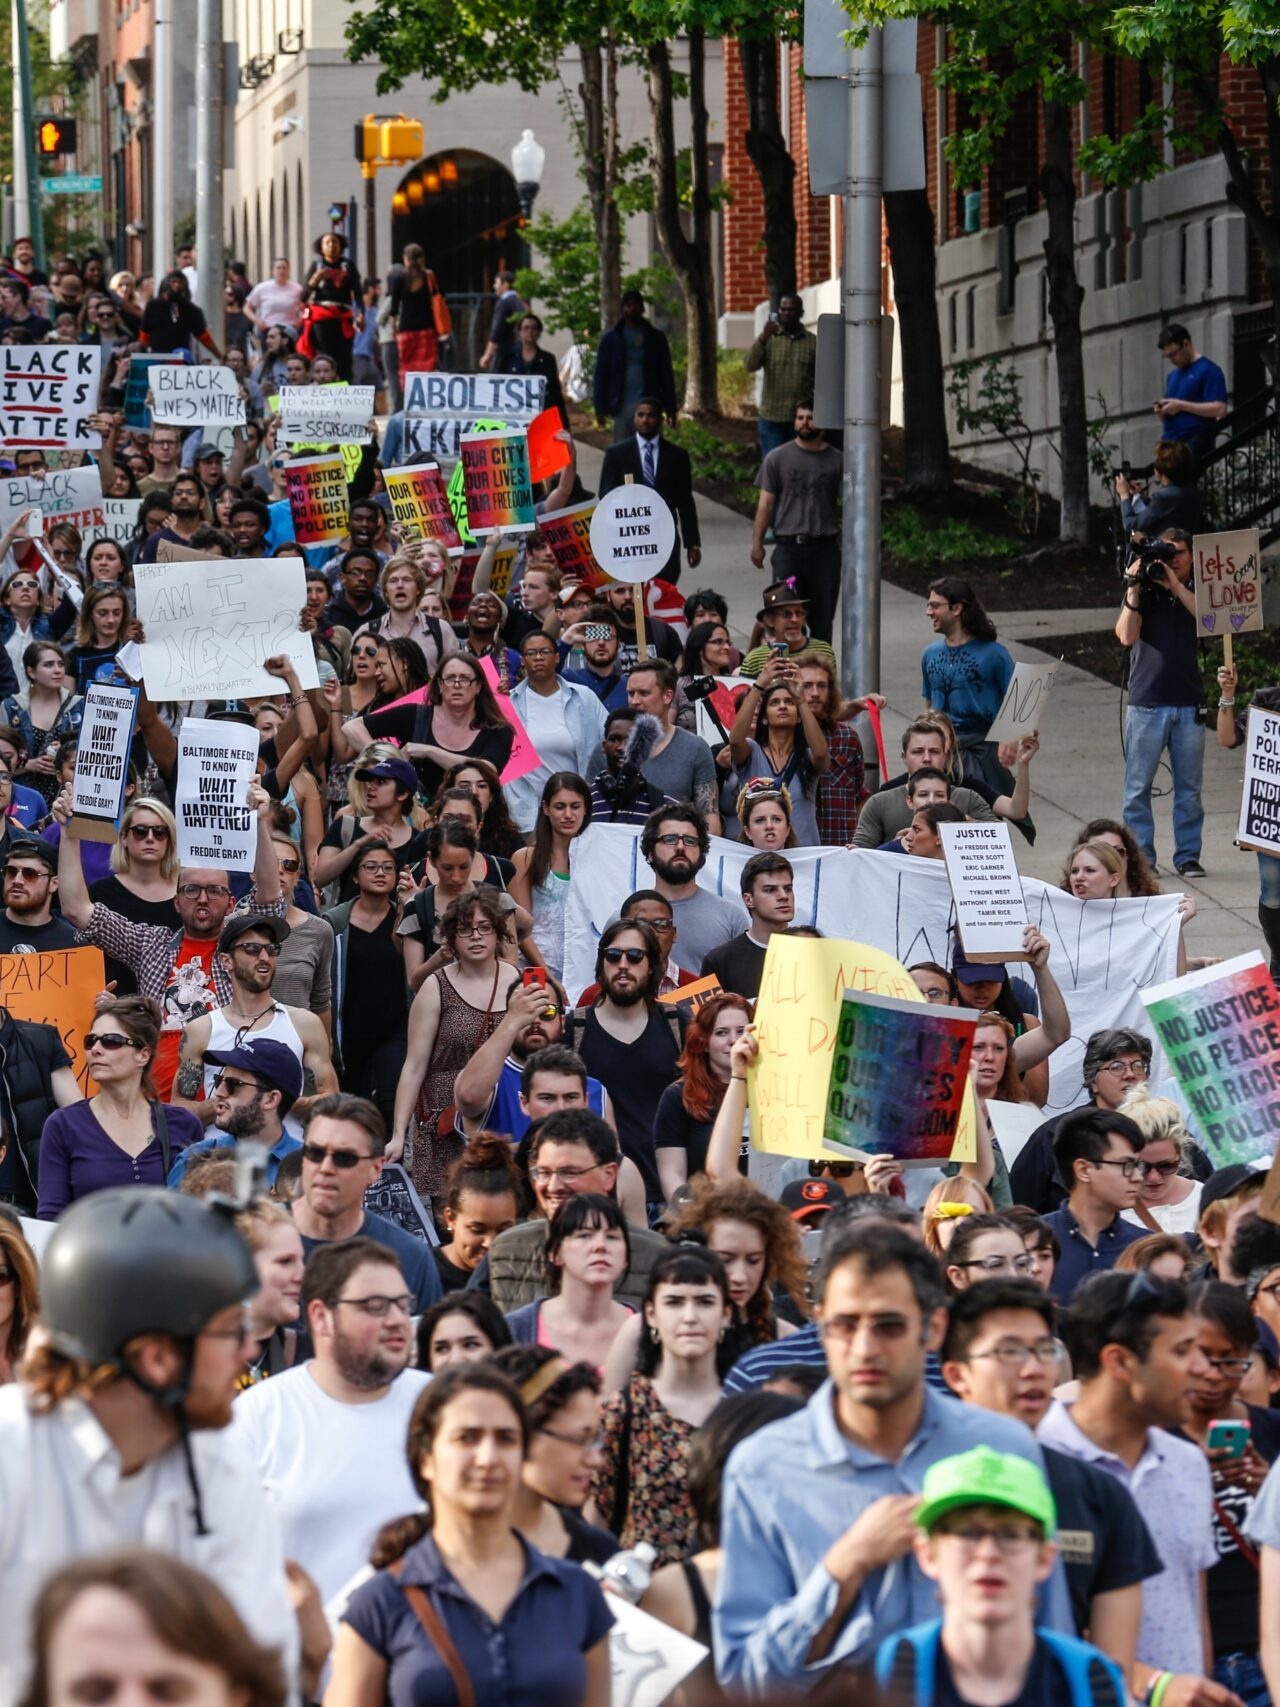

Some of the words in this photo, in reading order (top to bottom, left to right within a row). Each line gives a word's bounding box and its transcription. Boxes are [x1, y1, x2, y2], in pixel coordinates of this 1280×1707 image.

[158, 367, 223, 391] BLACK
[407, 375, 546, 413] ABOLISH
[153, 397, 197, 420] LIVES
[200, 393, 245, 420] MATTER
[463, 450, 486, 468] OUR
[491, 443, 526, 465] CITY
[8, 474, 78, 506] BLACK
[289, 475, 302, 487] NO
[389, 482, 413, 501] OUR
[414, 477, 441, 497] CITY
[466, 472, 490, 491] OUR
[492, 467, 526, 488] LIVES
[291, 490, 305, 502] NO
[308, 485, 342, 500] PEACE
[492, 490, 532, 511] FREEDOM
[309, 500, 347, 515] RACIST
[395, 503, 418, 522] OUR
[420, 498, 447, 518] LIVES
[615, 505, 652, 520] BLACK
[618, 524, 651, 539] LIVES
[613, 543, 658, 559] MATTER
[1199, 545, 1236, 584] Lets
[150, 583, 194, 623] AM
[207, 574, 246, 616] I
[1208, 581, 1256, 609] Love
[86, 693, 116, 708] BALTIMORE
[115, 697, 133, 711] NEEDS
[1000, 677, 1042, 724] NO
[103, 709, 118, 721] KNOW
[91, 724, 117, 752] WHAT
[182, 745, 230, 760] BALTIMORE
[231, 749, 255, 762] NEEDS
[202, 760, 211, 771] TO
[213, 761, 237, 773] KNOW
[76, 794, 97, 808] FREDDIE
[98, 797, 114, 810] GRAY?
[199, 777, 237, 804] WHAT
[213, 835, 223, 846] TO
[955, 829, 998, 839] JUSTICE
[190, 846, 221, 859] FREDDIE
[222, 848, 248, 861] GRAY?
[0, 952, 77, 991] PART
[840, 1017, 888, 1052] OUR
[1160, 1016, 1191, 1048] NO
[1174, 1050, 1207, 1083] NO
[1208, 1021, 1280, 1070] PEACE
[834, 1053, 881, 1090] OUR
[831, 1089, 871, 1127] OUR
[1191, 1085, 1223, 1117] NO
